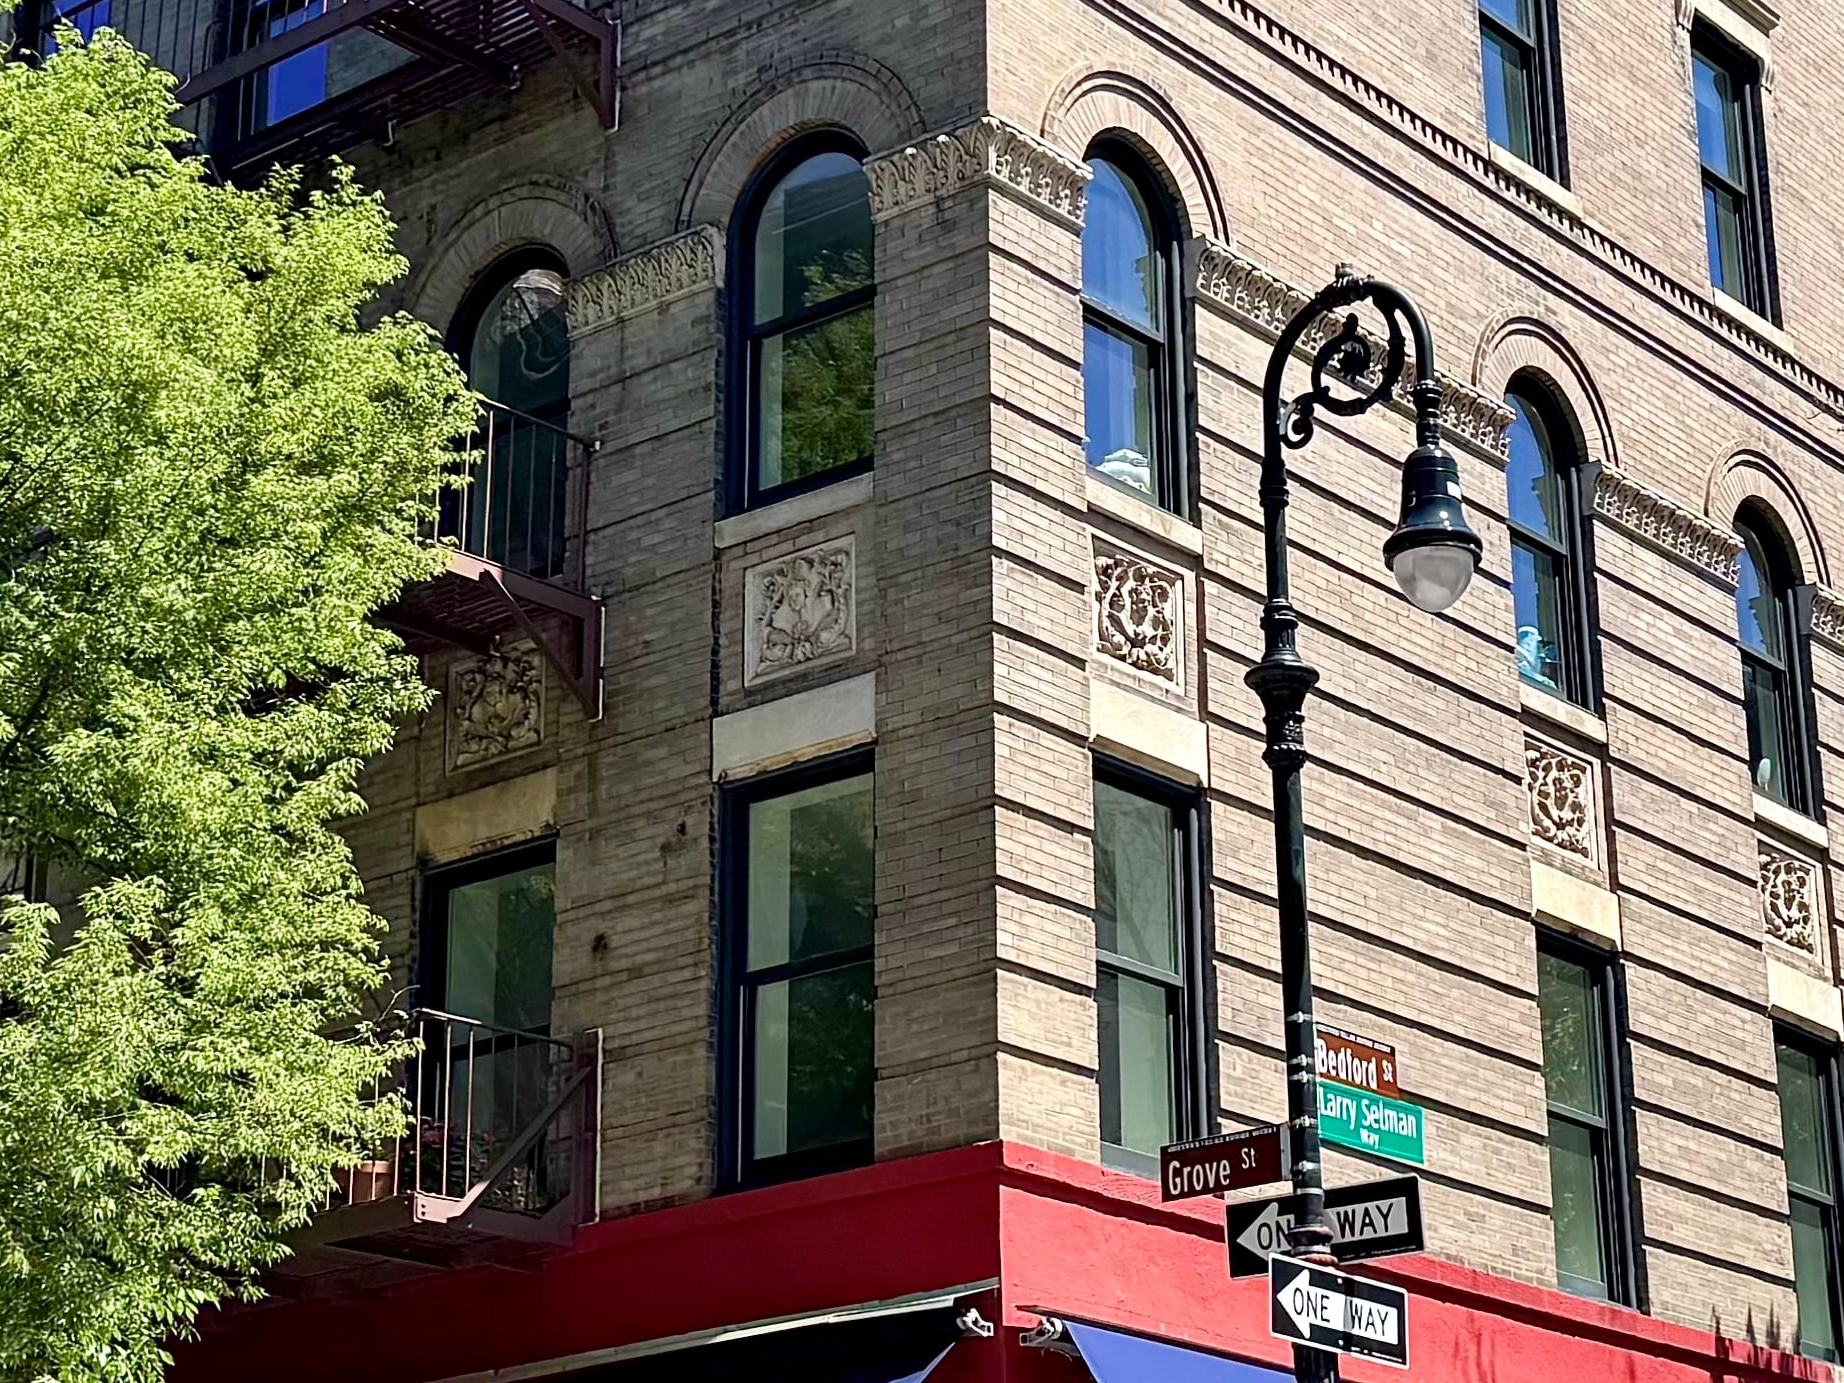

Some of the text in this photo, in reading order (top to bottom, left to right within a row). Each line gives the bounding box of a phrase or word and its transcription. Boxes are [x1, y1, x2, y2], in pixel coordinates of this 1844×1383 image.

[1317, 1038, 1377, 1090] Bedford
[1383, 1059, 1393, 1083] St
[1320, 1087, 1417, 1138] Larry Selman
[1359, 1127, 1380, 1150] Way
[1168, 1147, 1256, 1195] Grove St
[1257, 1202, 1394, 1250] ON WAY
[1293, 1287, 1389, 1337] ONE WAY
